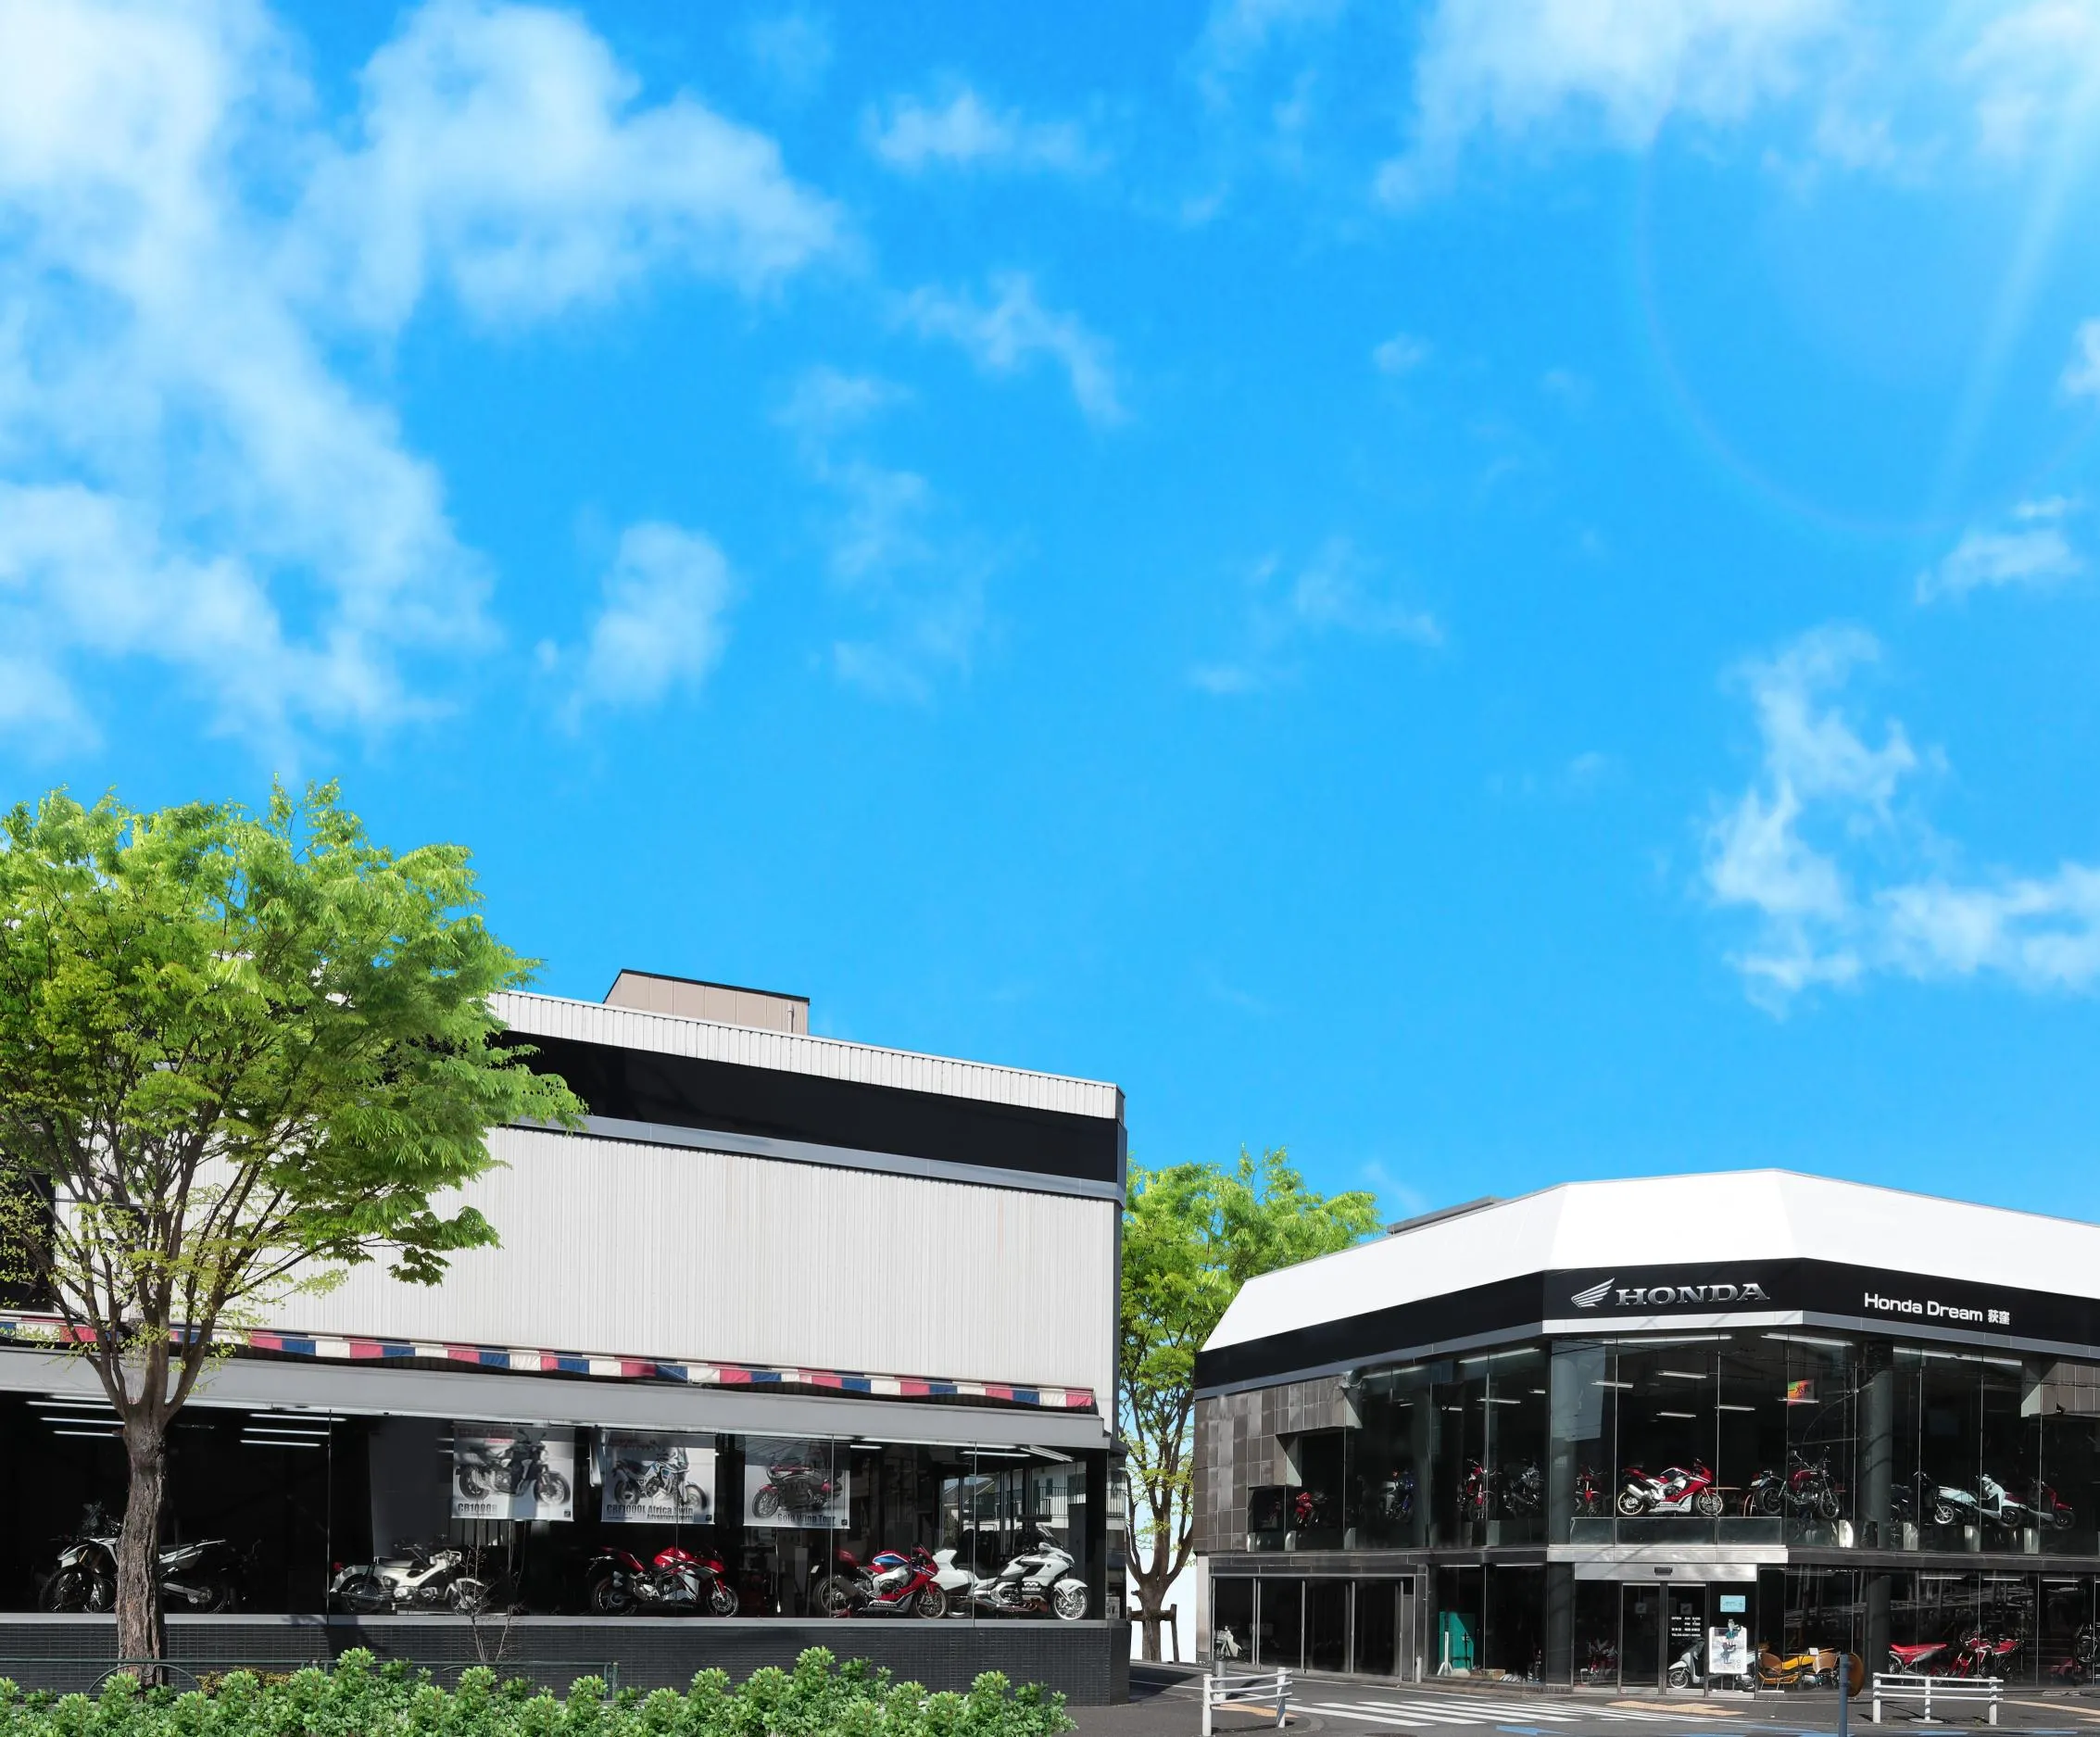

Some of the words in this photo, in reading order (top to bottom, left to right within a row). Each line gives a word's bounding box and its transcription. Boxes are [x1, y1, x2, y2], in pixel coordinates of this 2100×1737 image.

[1616, 1283, 1770, 1306] HONDA
[1864, 1292, 1923, 1315] Honda
[1927, 1301, 1983, 1322] Dream
[1987, 1309, 2010, 1326] 荻窪
